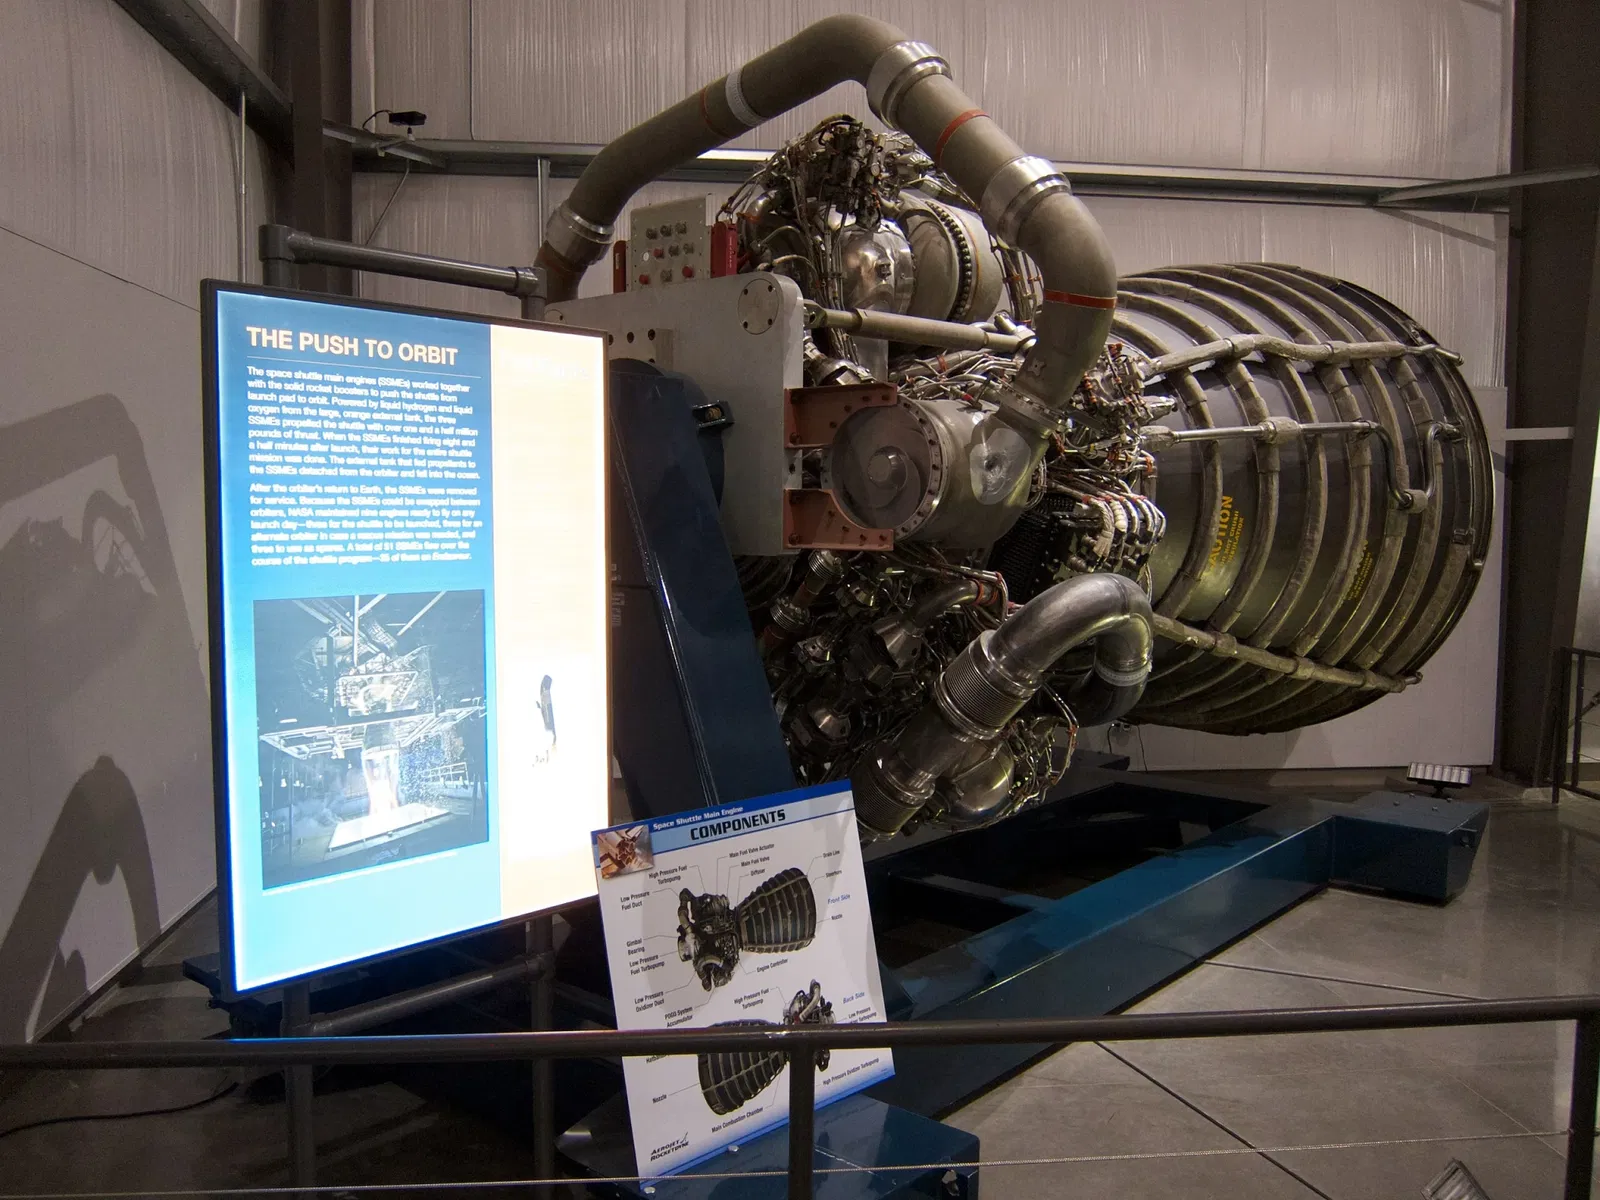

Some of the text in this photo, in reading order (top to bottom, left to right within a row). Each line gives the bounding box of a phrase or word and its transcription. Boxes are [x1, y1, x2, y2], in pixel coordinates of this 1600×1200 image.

[246, 326, 458, 365] THE PUSH TO ORBIT
[247, 366, 469, 393] The space shuttle main engines (SSMEs) worked together
[247, 378, 457, 402] with the solid rocket boosters to push the shuttle from
[247, 391, 473, 415] launch pad to orbit. Powered by liquid hydrogen and liquid
[1229, 510, 1240, 537] CRUSH
[653, 806, 744, 831] Space Shuttle Main Engine
[690, 809, 786, 841] COMPONENTS
[648, 864, 688, 880] High Pressure Fuel
[620, 890, 650, 903] Low Pressure
[828, 896, 840, 904] Front
[622, 900, 643, 912] Fuel Duct
[626, 938, 642, 947] Gimbal
[628, 946, 645, 956] Bearing
[630, 954, 658, 968] Low Pressure
[641, 961, 665, 972] Turbopump
[644, 991, 664, 1001] Pressure
[744, 991, 760, 1001] Pressure
[761, 988, 770, 996] Fuel
[843, 992, 865, 1004] Back Side
[654, 998, 664, 1006] Duct
[652, 1094, 667, 1104] Nozzle
[712, 1107, 764, 1133] Main Combustion Chamber
[650, 1141, 689, 1162] ROCKETDYNE
[651, 1139, 680, 1156] AEROJET
